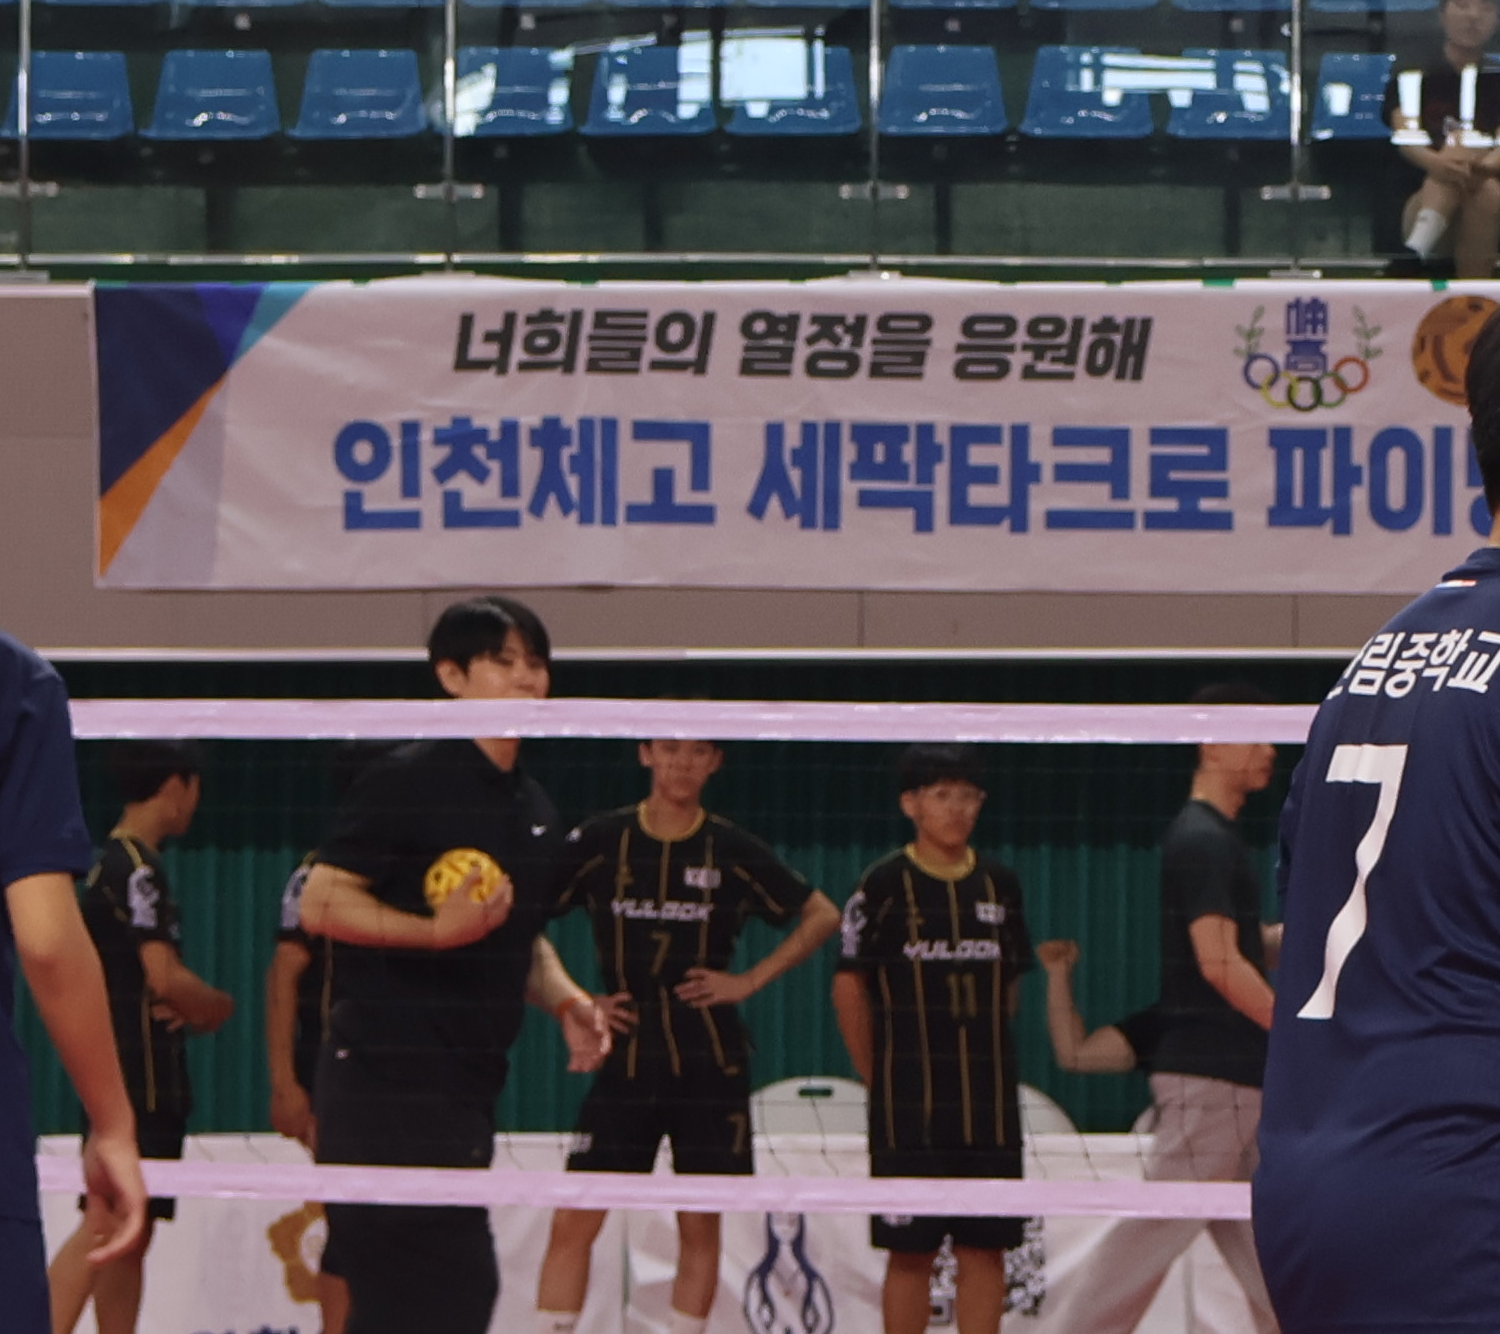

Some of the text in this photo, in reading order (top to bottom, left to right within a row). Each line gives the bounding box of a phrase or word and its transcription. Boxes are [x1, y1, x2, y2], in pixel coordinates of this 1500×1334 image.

[453, 309, 1154, 384] 너희들의 열정을 응원해
[334, 416, 1493, 536] 인천체고 세팍타크로 파이
[1296, 743, 1408, 1020] 7
[650, 930, 672, 977] 7
[945, 972, 977, 1018] 11
